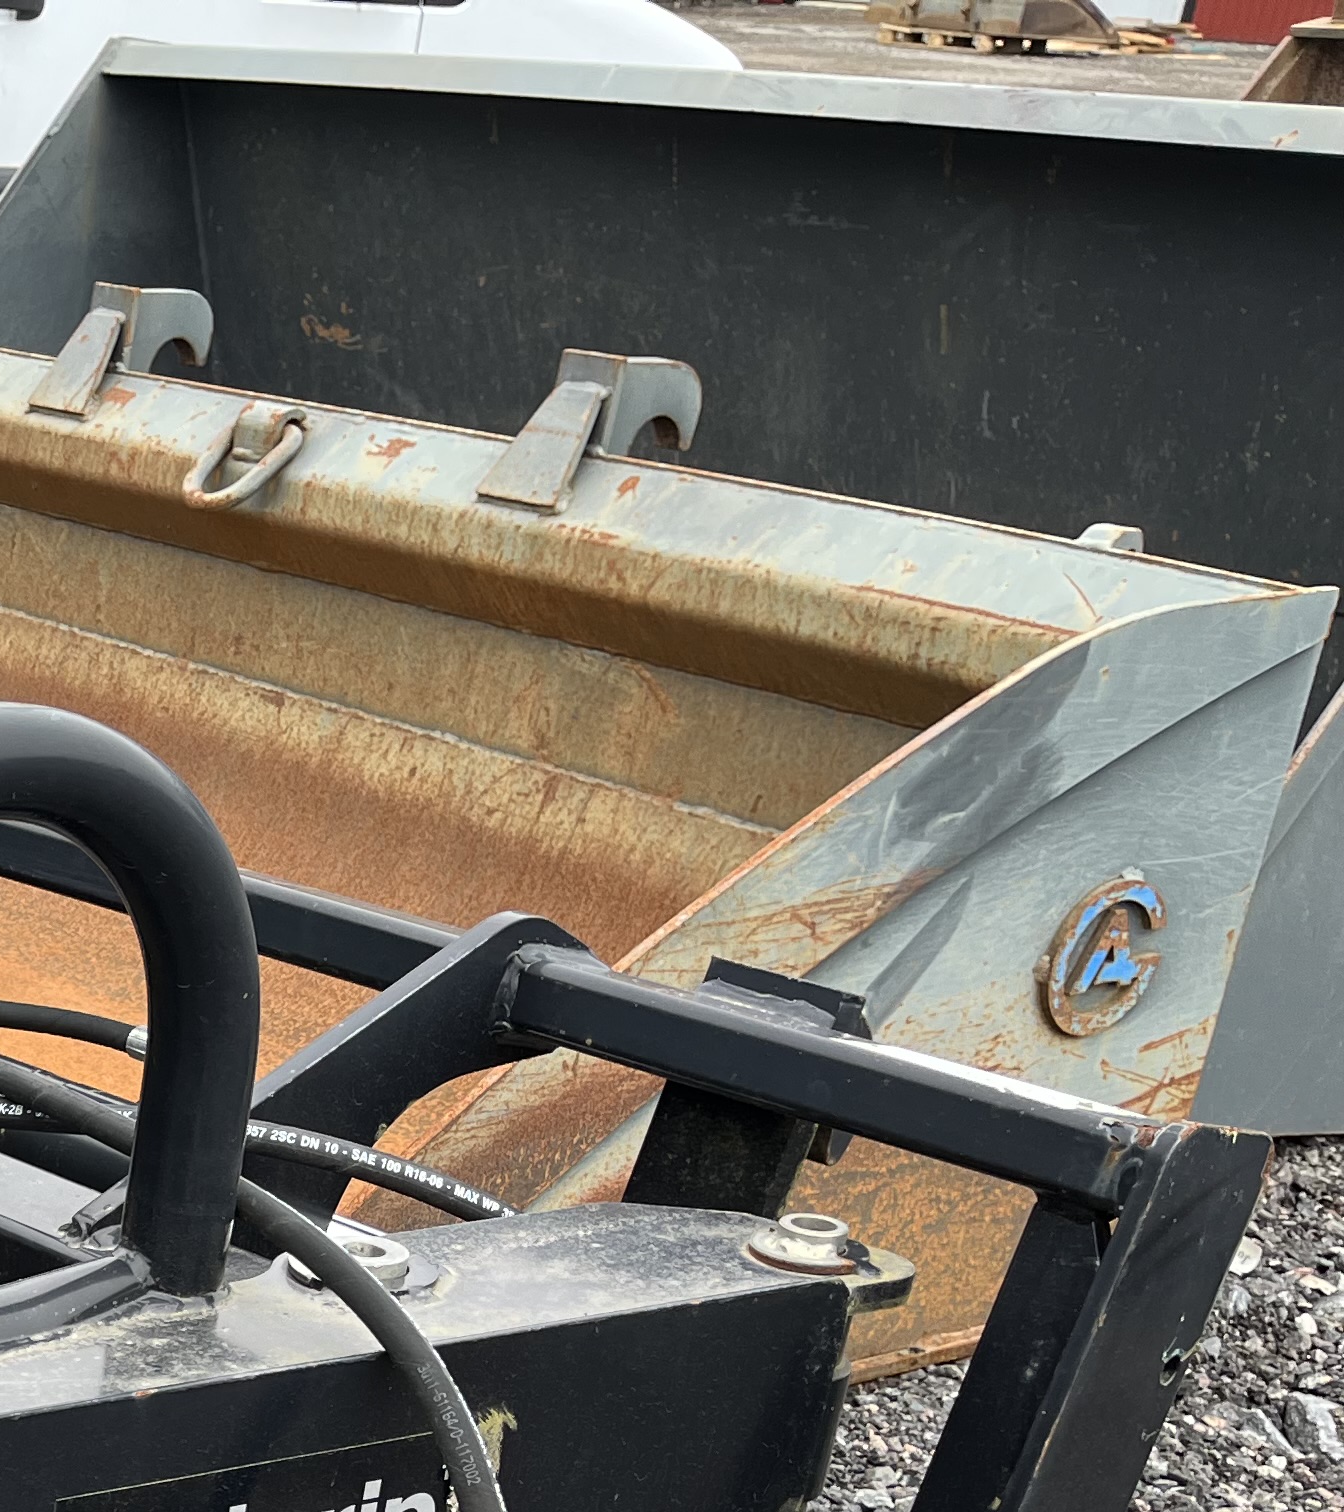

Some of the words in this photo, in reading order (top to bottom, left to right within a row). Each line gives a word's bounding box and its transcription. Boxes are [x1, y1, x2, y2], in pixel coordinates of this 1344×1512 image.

[269, 1129, 297, 1144] 2SC
[300, 1135, 320, 1150] DN
[324, 1141, 339, 1155] 10
[351, 1148, 377, 1166] SAE
[381, 1157, 401, 1174] 100
[454, 1183, 480, 1205] MAX
[482, 1196, 501, 1212] WP
